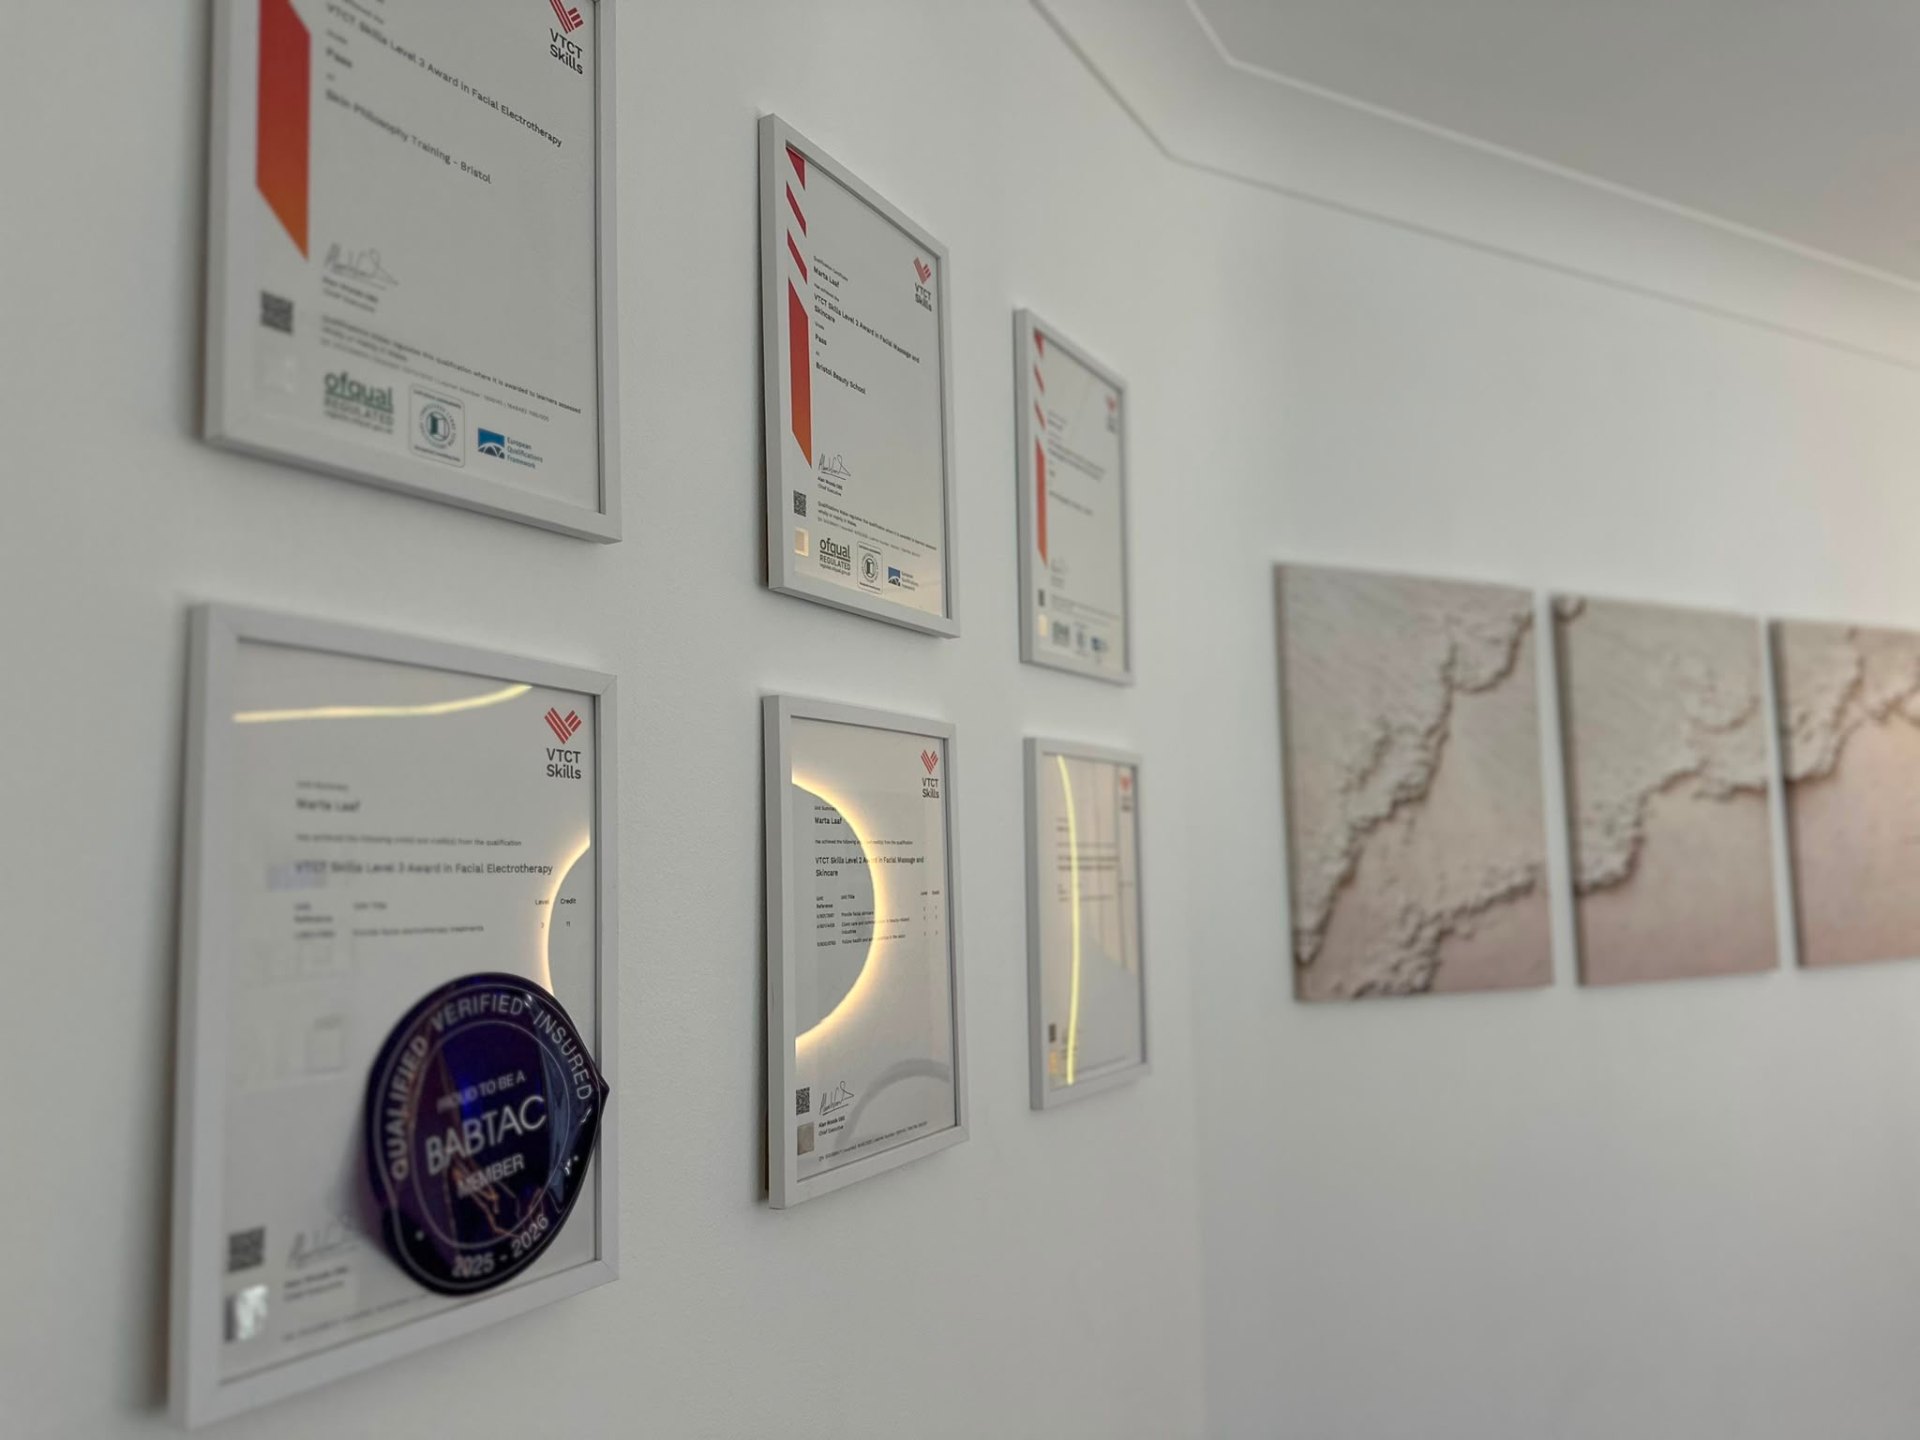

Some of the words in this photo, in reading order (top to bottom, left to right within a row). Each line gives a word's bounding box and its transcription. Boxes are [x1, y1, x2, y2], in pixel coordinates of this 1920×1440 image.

[549, 27, 583, 60] VTCT
[549, 44, 583, 75] Skills
[390, 40, 417, 64] Level
[427, 63, 458, 88] Award
[460, 81, 470, 93] in
[472, 88, 498, 110] Facial
[500, 104, 562, 148] Electrotherapy
[411, 135, 450, 166] Training
[460, 160, 491, 184] Bristol
[914, 282, 931, 301] VTCT
[915, 293, 932, 312] Skills
[814, 292, 827, 307] VTCT
[828, 302, 841, 316] Skills
[842, 311, 855, 325] Level
[859, 322, 874, 336] Award
[814, 305, 836, 323] Skincare
[815, 333, 827, 346] Pass
[816, 361, 832, 376] Bristol
[833, 370, 849, 387] Beauty
[849, 381, 866, 395] School
[324, 371, 393, 412] ofqual
[324, 397, 394, 425] REGULATED
[507, 436, 532, 450] European
[819, 537, 851, 560] ofqual
[819, 554, 851, 571] REGULATED
[546, 747, 581, 764] VTCT
[546, 763, 582, 780] Skills
[921, 777, 939, 788] VTCT
[922, 788, 940, 799] Skills
[814, 817, 830, 825] Marta
[486, 838, 522, 848] qualification
[407, 862, 440, 874] Award
[443, 862, 452, 873] in
[455, 862, 484, 874] Facial
[487, 862, 553, 876] Electrotherapy
[830, 856, 844, 864] Skills
[897, 857, 916, 866] Massage
[815, 869, 839, 877] Skincare
[560, 897, 577, 906] Credit
[386, 1033, 429, 1181] QUALIFIED
[430, 992, 524, 1032] VERIFIED
[532, 1007, 593, 1101] INSURED
[479, 1081, 496, 1096] TO
[497, 1075, 514, 1091] BE
[515, 1069, 526, 1084] A
[425, 1094, 548, 1177] BABTAC
[457, 1153, 526, 1198] MEMBER
[451, 1254, 496, 1278] 2025
[511, 1214, 550, 1258] 2026
